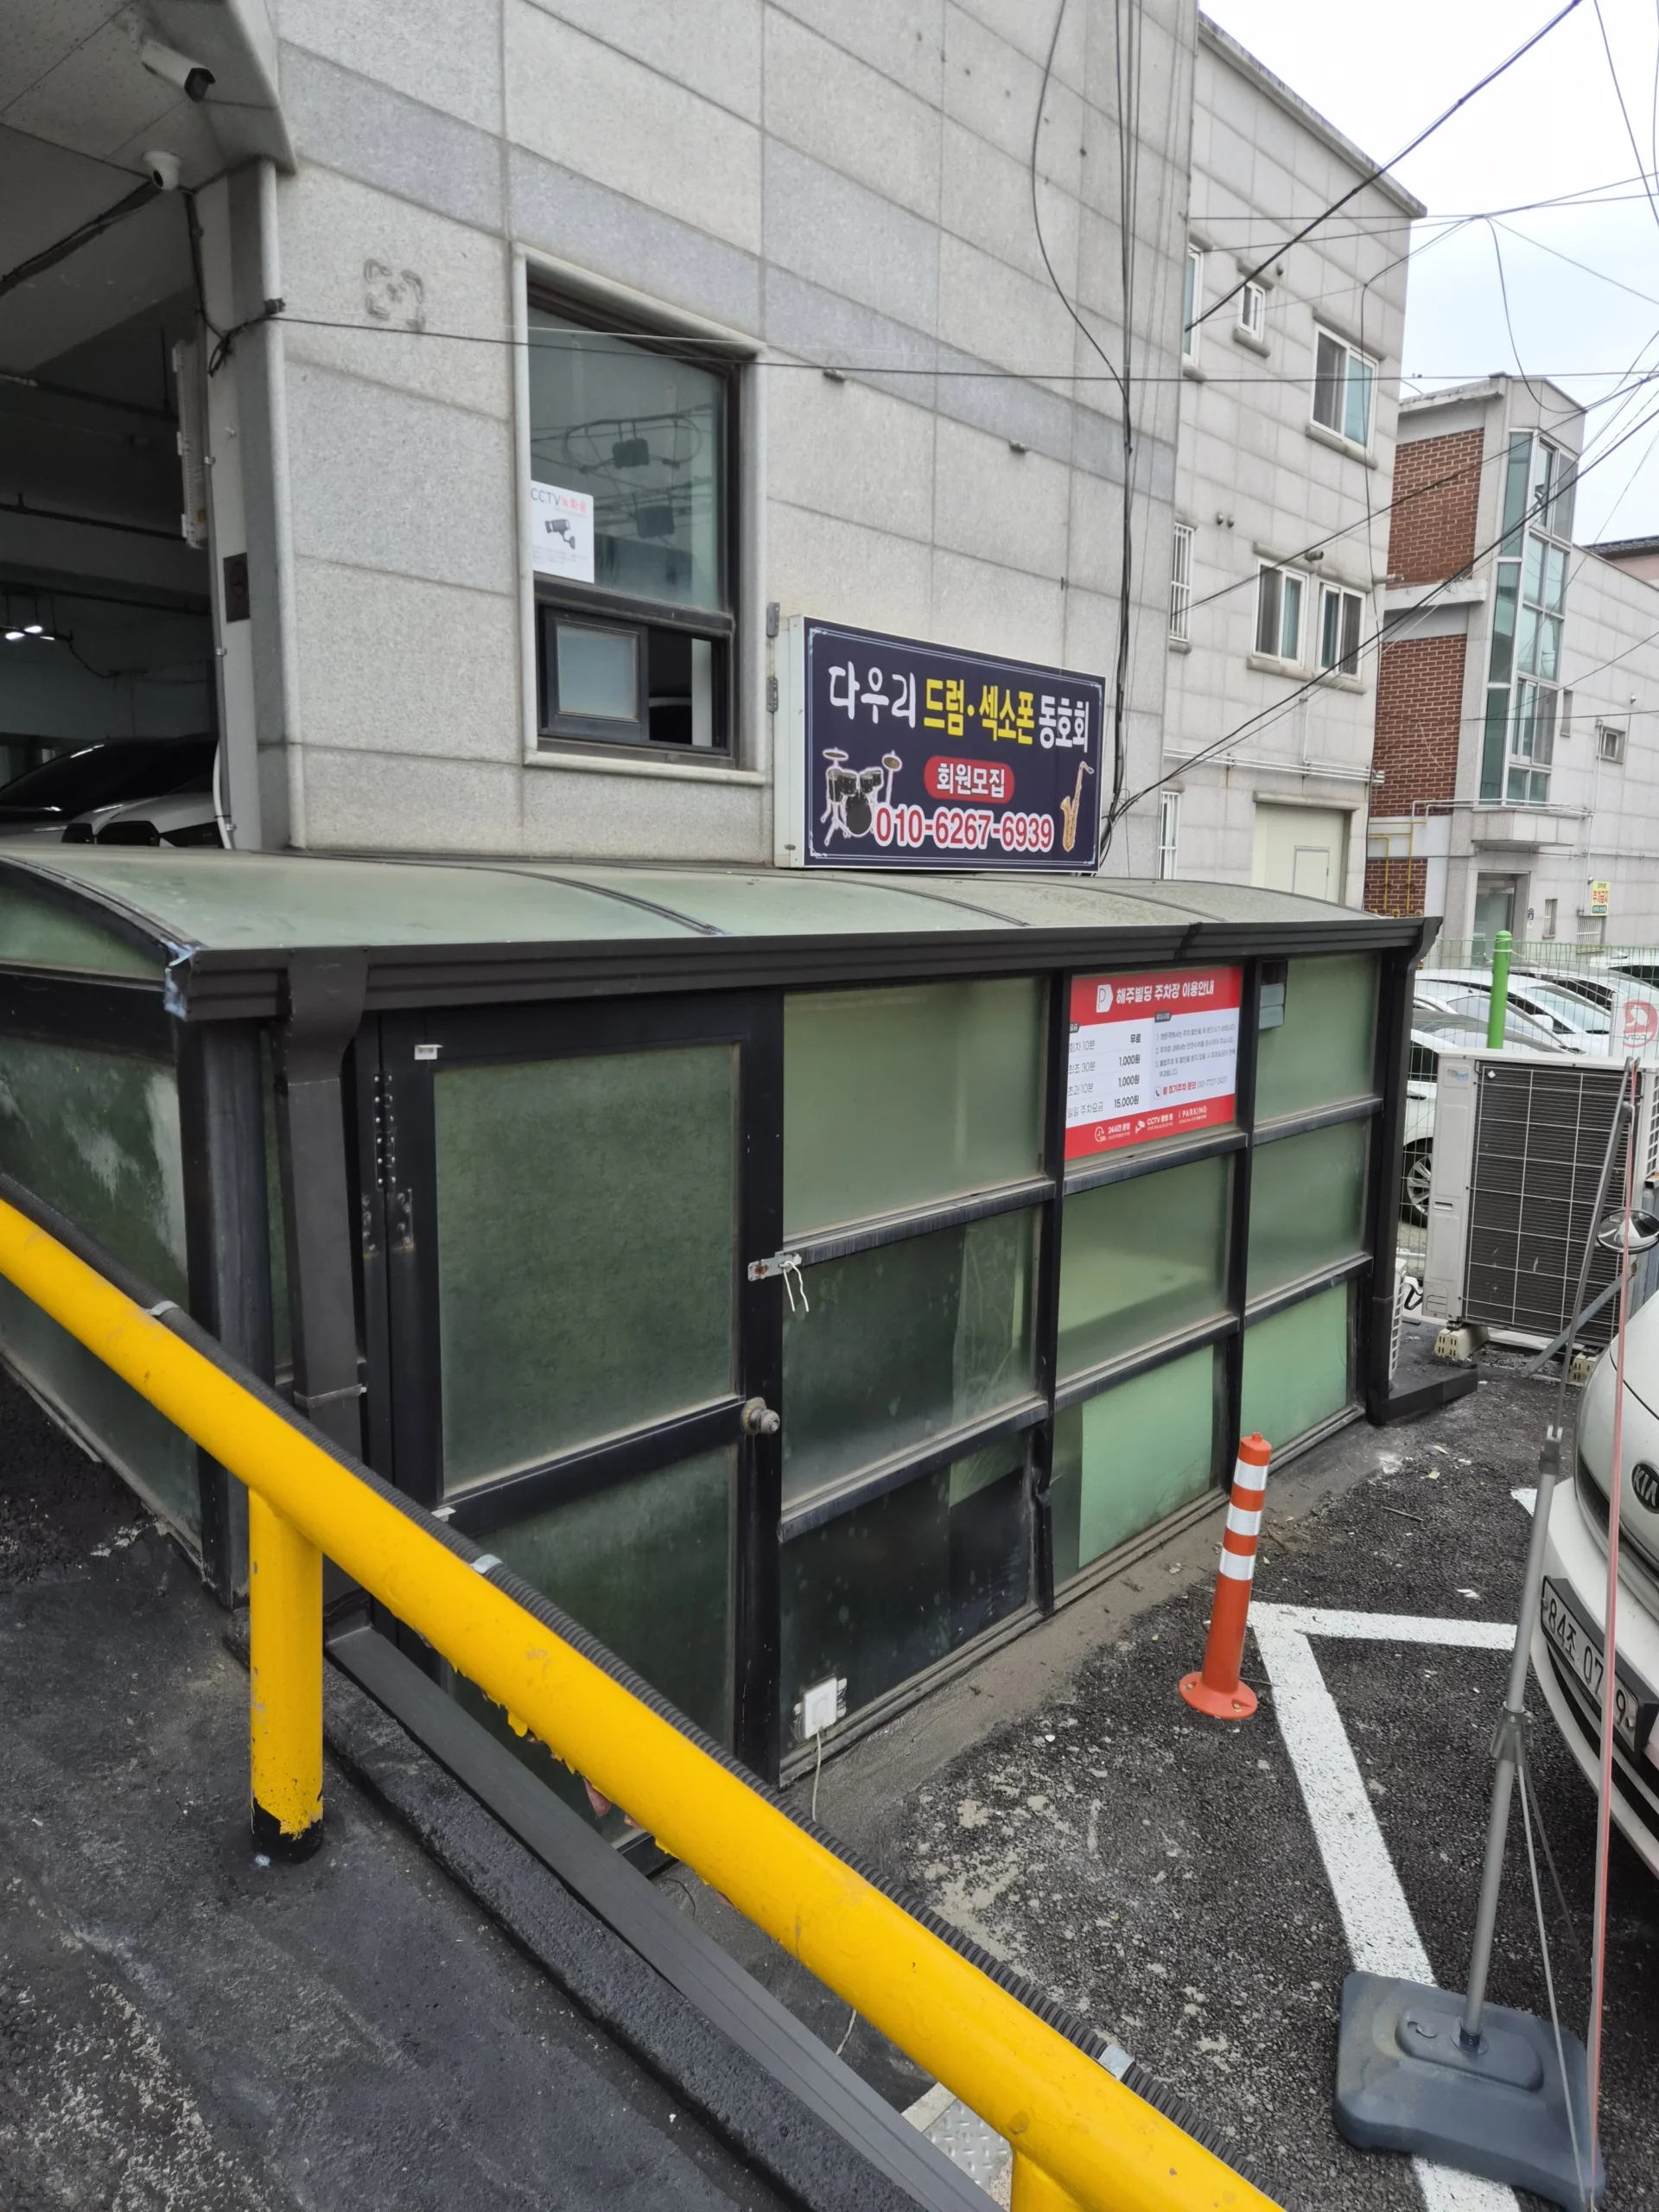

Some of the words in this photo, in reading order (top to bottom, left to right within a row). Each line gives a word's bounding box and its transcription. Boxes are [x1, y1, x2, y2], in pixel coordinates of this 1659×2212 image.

[531, 487, 561, 505] CCTV
[828, 661, 916, 728] 다우리
[1039, 695, 1090, 753] 동호회
[937, 762, 1006, 799] 회원모집
[875, 805, 1054, 851] 010-6267-6939
[1116, 985, 1152, 1004] 해주빌딩
[1154, 982, 1180, 1001] 주차장
[1182, 980, 1214, 997] 이용안내
[1068, 1041, 1081, 1052] 회차
[1083, 1039, 1095, 1051] 10분
[1130, 1033, 1141, 1044] 무료
[1067, 1063, 1080, 1075] 최초
[1082, 1061, 1096, 1073] 30분
[1119, 1053, 1141, 1067] 1,000원
[1067, 1084, 1080, 1096] 초과
[1081, 1083, 1094, 1095] 10분
[1118, 1074, 1140, 1088] 1,000원
[1168, 1083, 1186, 1094] 정기주차
[1187, 1081, 1196, 1090] 문의
[1067, 1106, 1079, 1118] 일일
[1080, 1101, 1103, 1115] 주차요금
[1114, 1095, 1139, 1109] 15,000원
[1147, 1117, 1160, 1126] CCTV
[1633, 1465, 1658, 1507] KIA
[1584, 1645, 1626, 1726] 079
